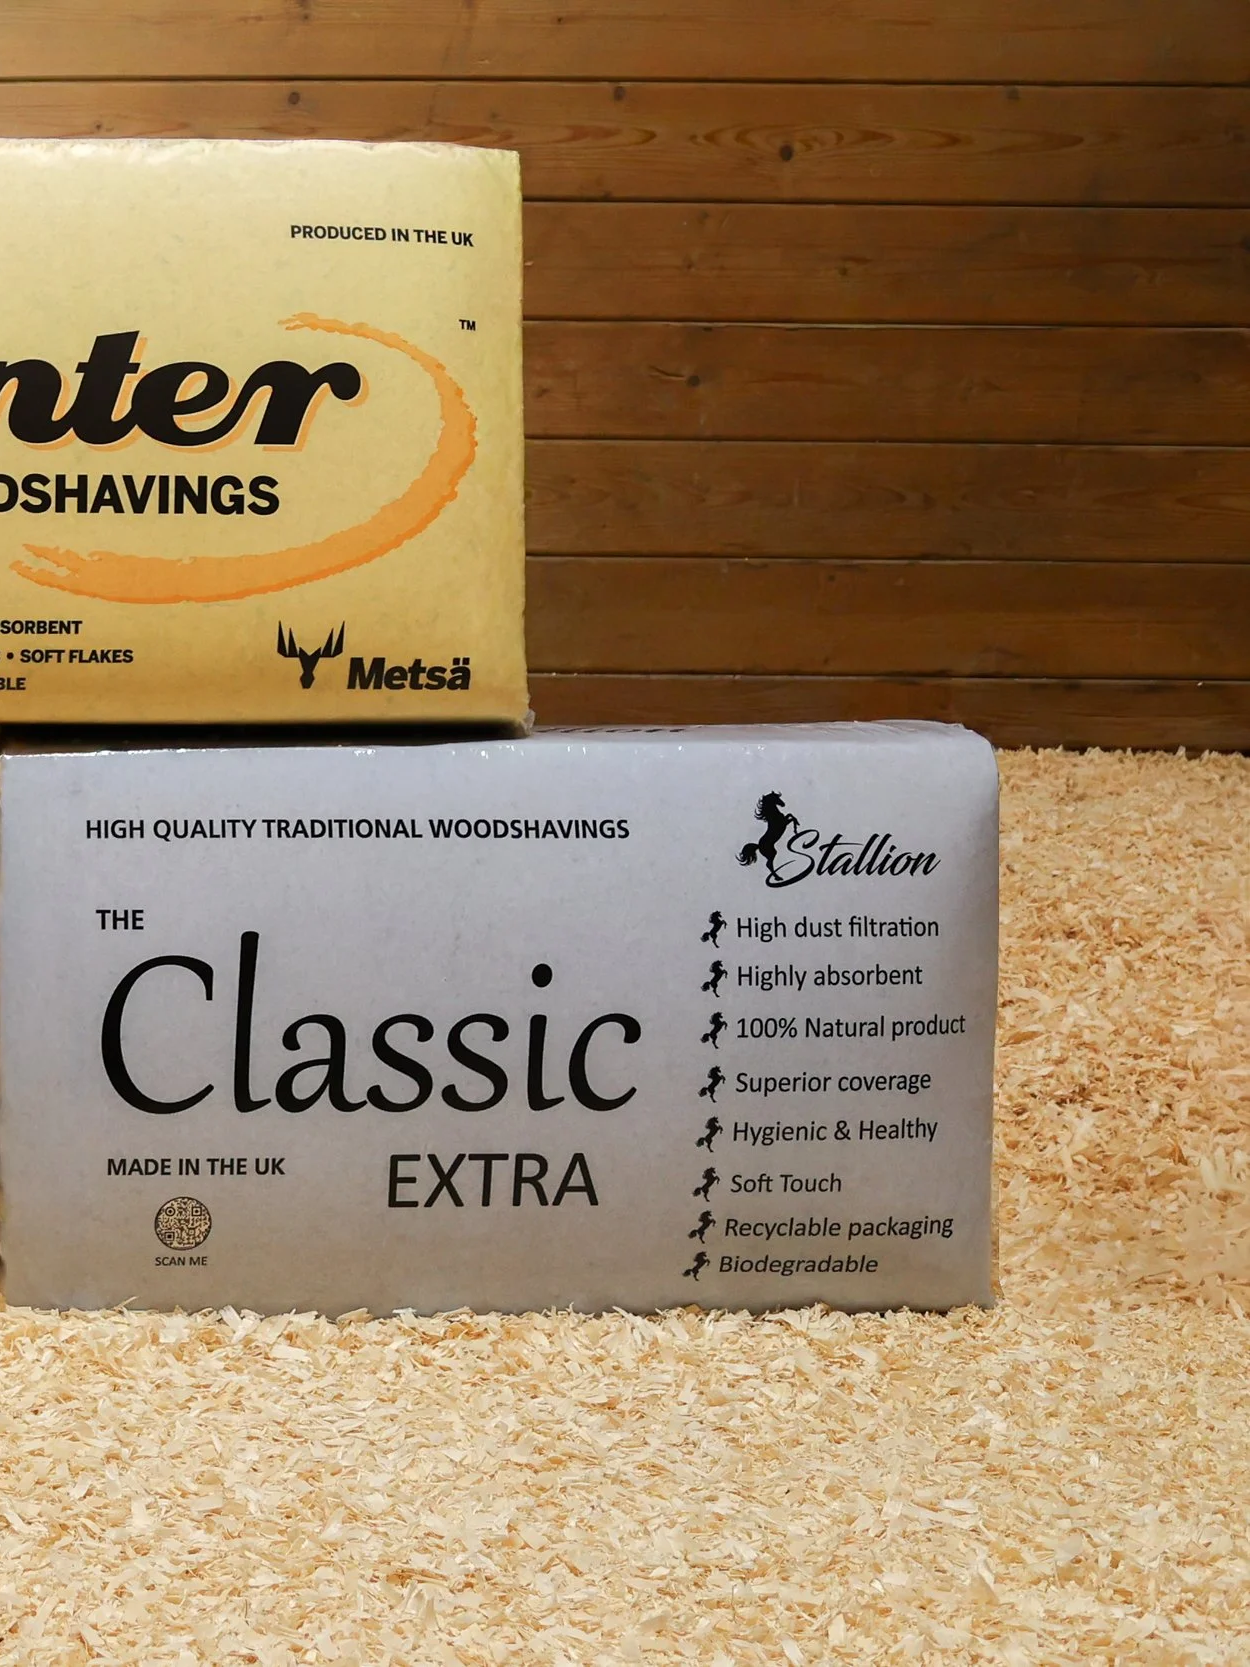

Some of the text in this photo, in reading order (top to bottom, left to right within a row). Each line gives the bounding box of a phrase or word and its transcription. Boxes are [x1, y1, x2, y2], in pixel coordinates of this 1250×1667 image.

[290, 224, 474, 248] PRODUCED IN THE UK
[19, 648, 66, 664] SOFT
[68, 649, 134, 664] FLAKES
[346, 656, 471, 691] Metsä
[86, 818, 630, 842] HIGH QUALITY TRADITIONAL WOODSHAVINGS
[765, 828, 941, 889] Stallion
[95, 909, 144, 930] THE
[737, 915, 939, 943] High dust filtration
[737, 963, 923, 992] Highly absorbent
[101, 930, 642, 1115] Classic
[736, 1013, 966, 1042] 100% Natural product
[735, 1071, 932, 1098] Superior coverage
[733, 1117, 938, 1147] Hygienic & Healthy
[107, 1157, 286, 1176] MADE IN THE UK
[387, 1152, 599, 1208] EXTRA
[730, 1172, 842, 1193] Soft Touch
[725, 1215, 954, 1241] Recyclable packaging
[155, 1256, 208, 1267] SCAN ME
[719, 1254, 879, 1277] Biodegradable
